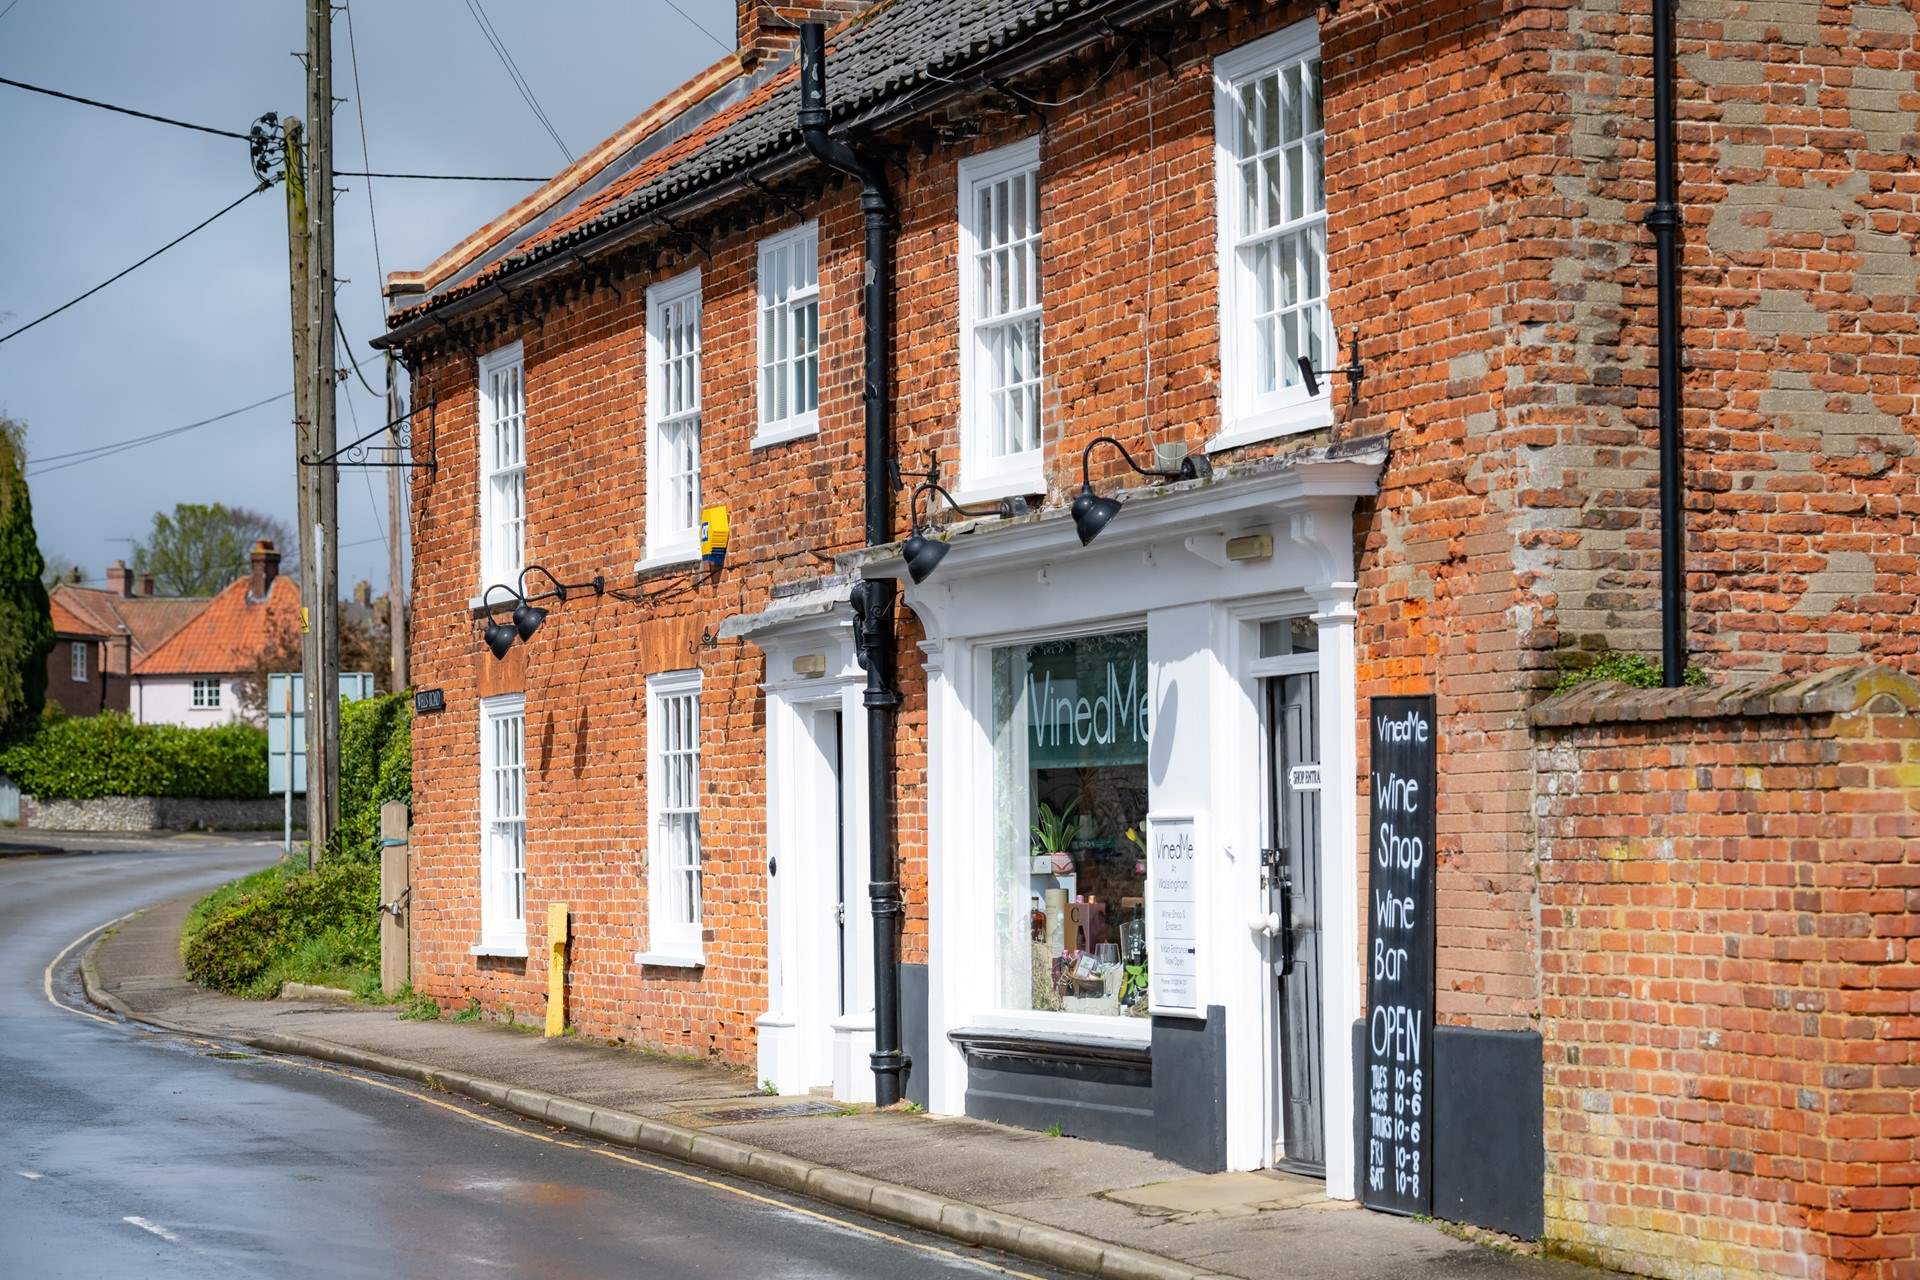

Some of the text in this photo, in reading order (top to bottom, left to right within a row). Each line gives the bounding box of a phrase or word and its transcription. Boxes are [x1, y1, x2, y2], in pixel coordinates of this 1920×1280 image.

[1377, 710, 1428, 742] VinedMe
[1376, 772, 1419, 812] Wine
[1378, 822, 1423, 879] Shop
[1376, 888, 1415, 929] Wine
[1374, 938, 1408, 980] Bar
[1371, 1005, 1421, 1064] OPEN
[1371, 1065, 1388, 1089] TUES
[1370, 1089, 1388, 1112] WEDS
[1370, 1112, 1392, 1139] THURS
[1370, 1138, 1383, 1166] FRI
[1370, 1167, 1385, 1191] SAT
